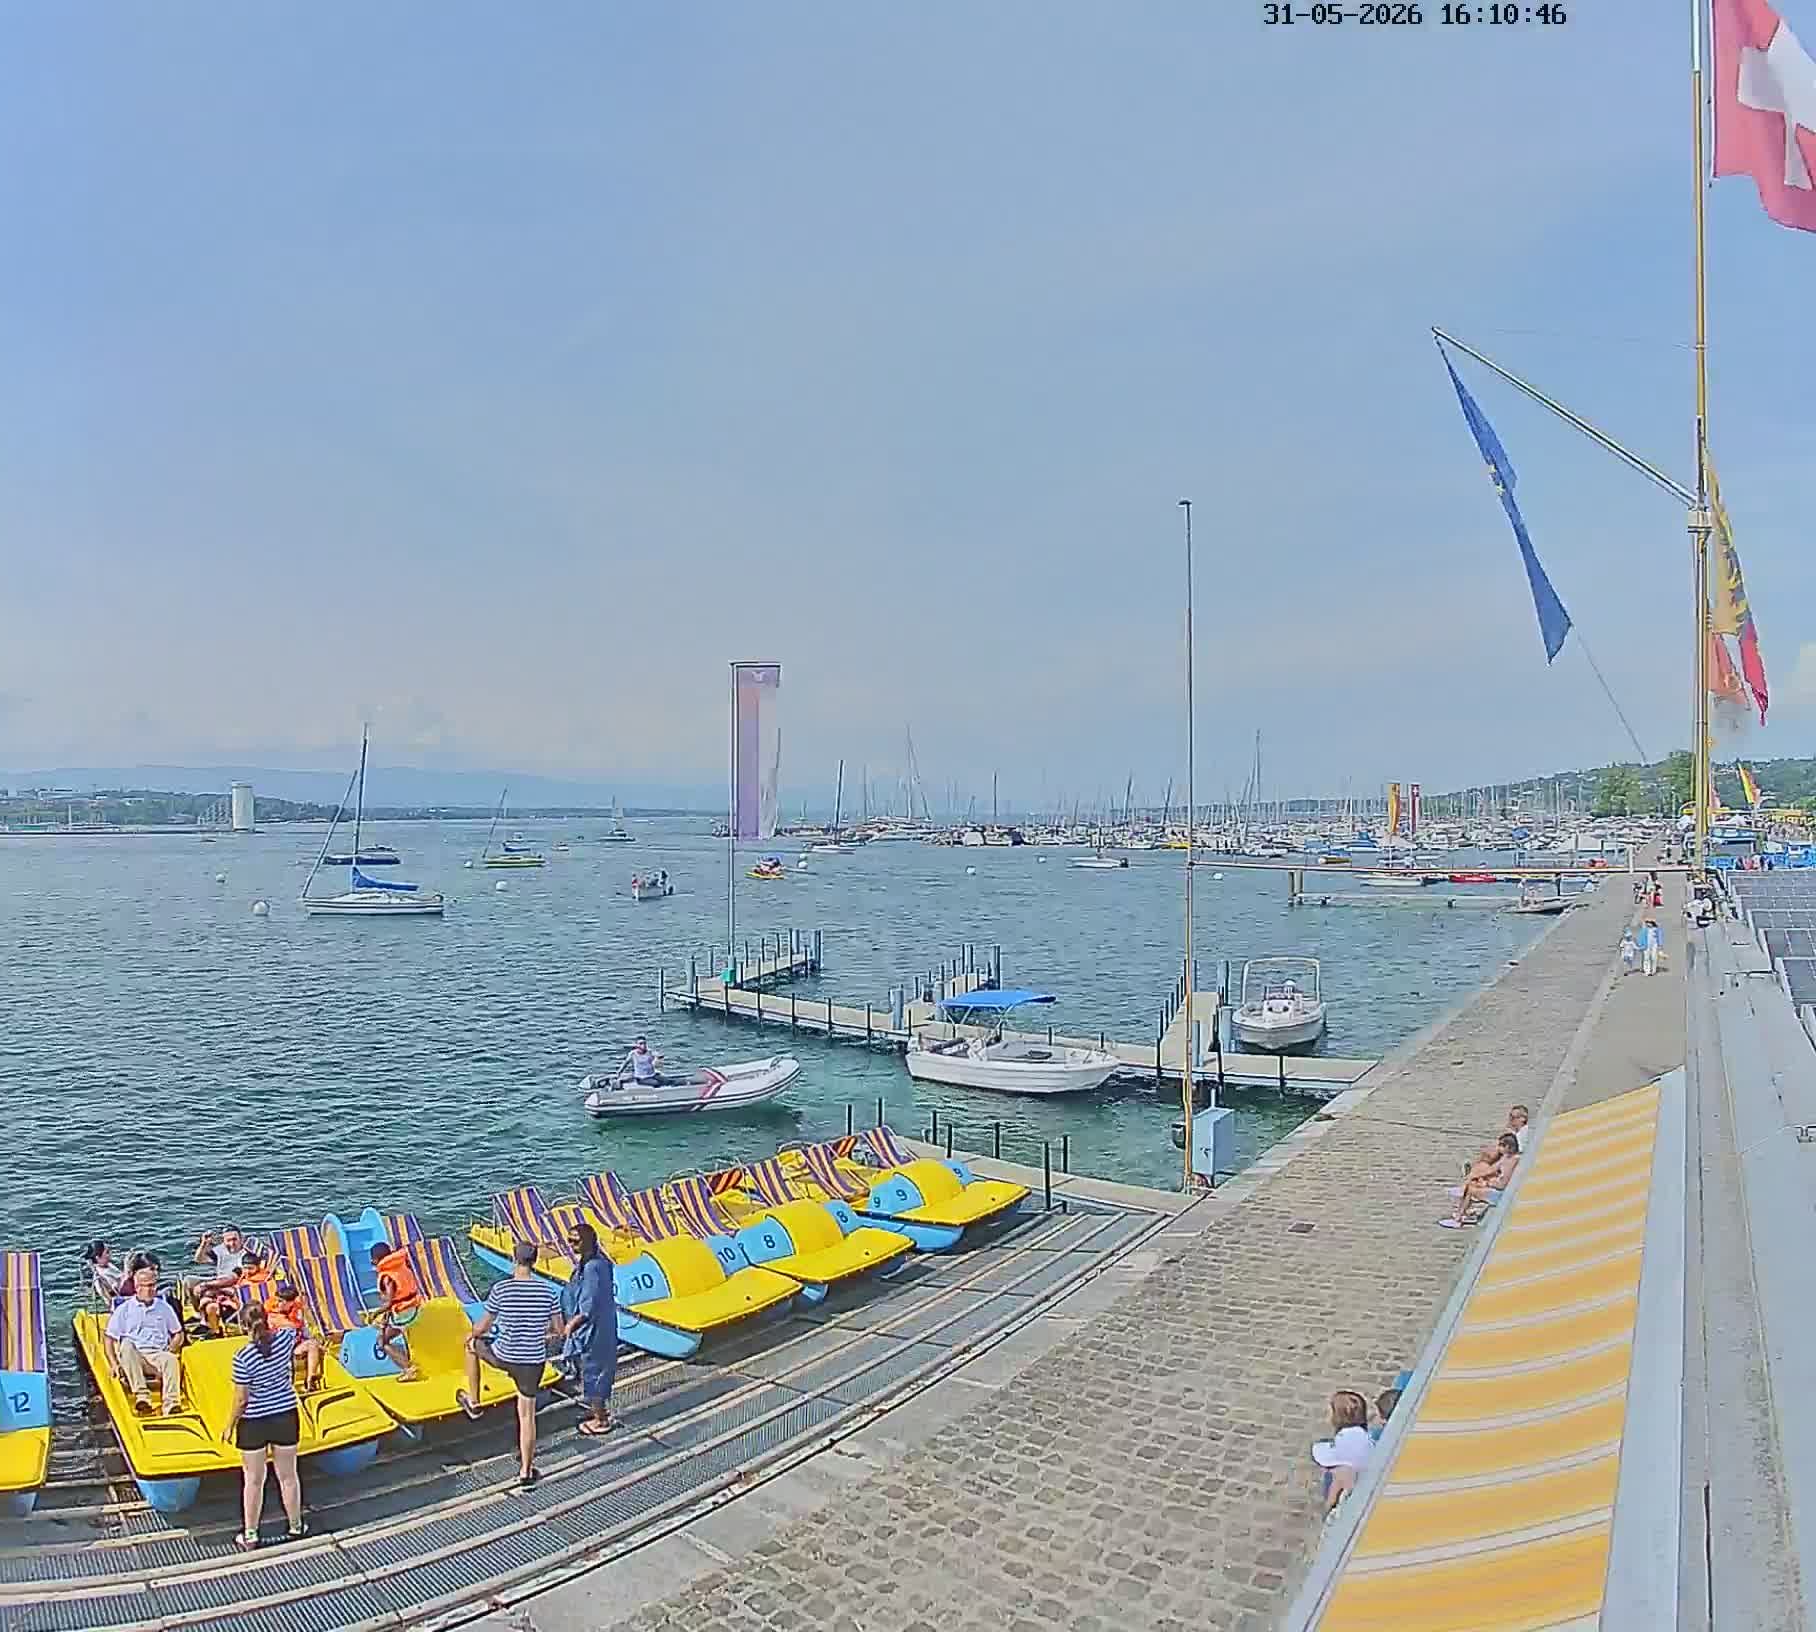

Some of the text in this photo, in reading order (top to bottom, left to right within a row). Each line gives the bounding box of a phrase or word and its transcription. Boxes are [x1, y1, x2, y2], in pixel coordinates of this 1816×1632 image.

[896, 1189, 907, 1201] 9
[874, 1197, 881, 1208] 9
[837, 1211, 848, 1223] 8
[764, 1235, 775, 1248] 8
[718, 1247, 736, 1263] 10
[632, 1273, 654, 1290] 10
[8, 1391, 31, 1413] 12
